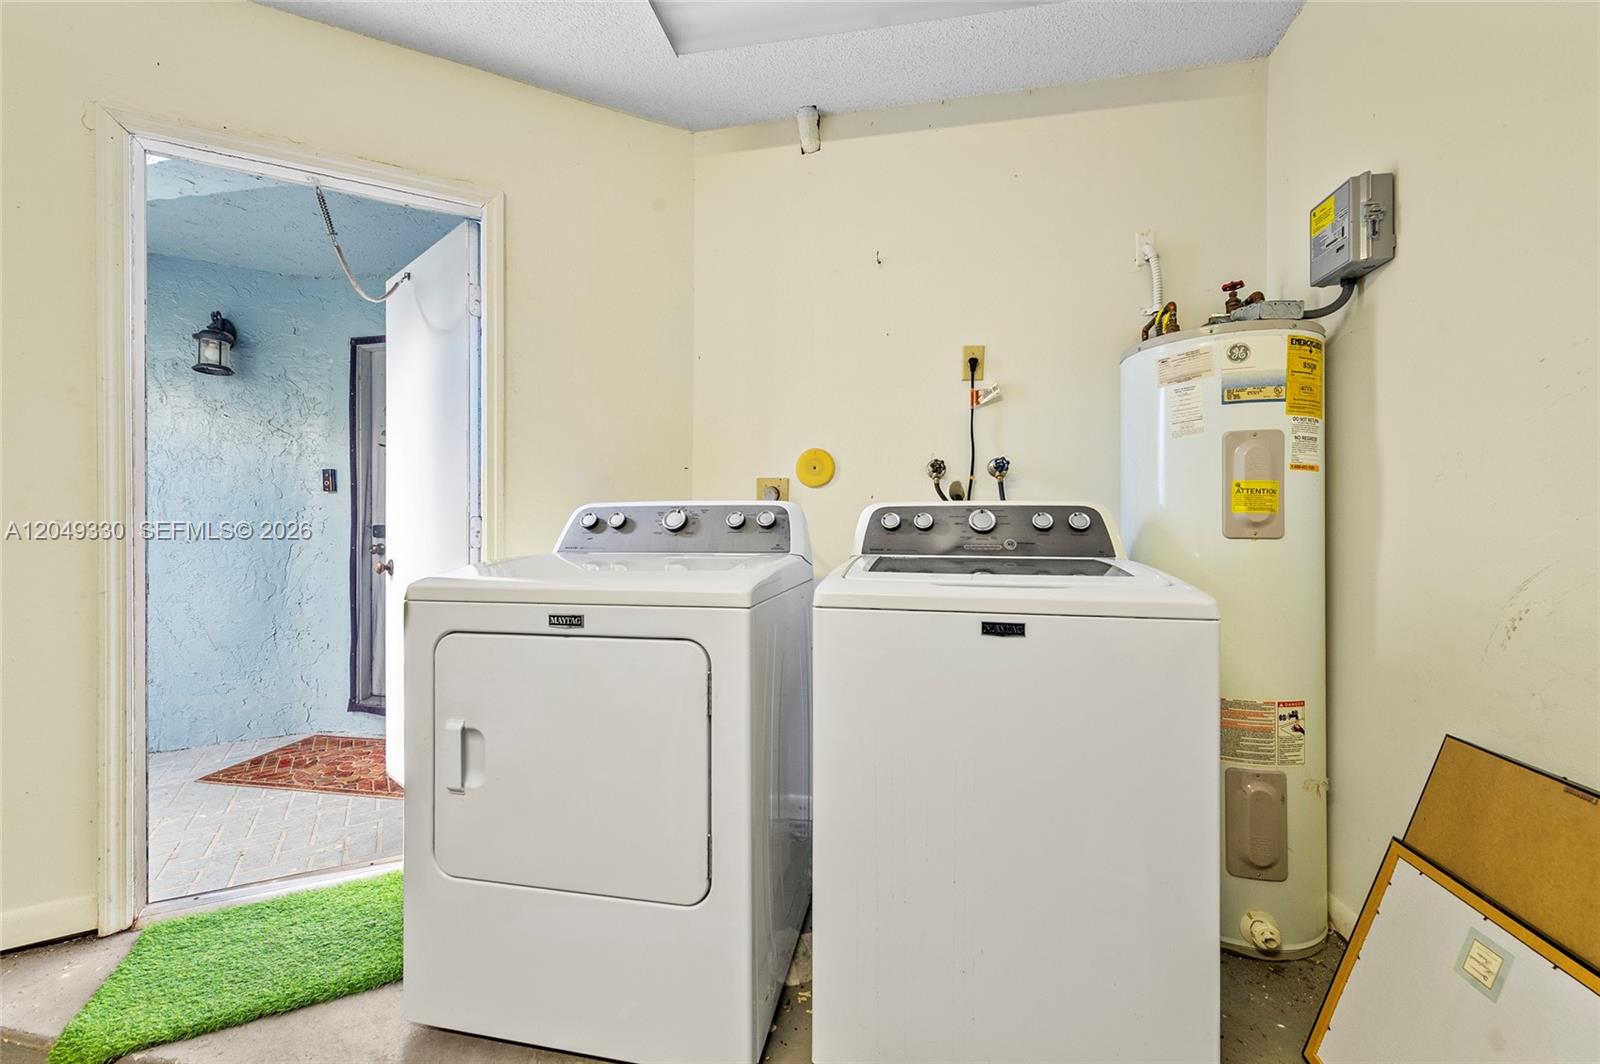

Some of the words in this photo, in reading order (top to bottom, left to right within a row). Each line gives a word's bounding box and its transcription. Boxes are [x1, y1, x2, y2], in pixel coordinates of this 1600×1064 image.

[1235, 487, 1276, 495] ATTENTION
[550, 616, 581, 625] MAYTAG
[983, 624, 1024, 634] MAYTAG
